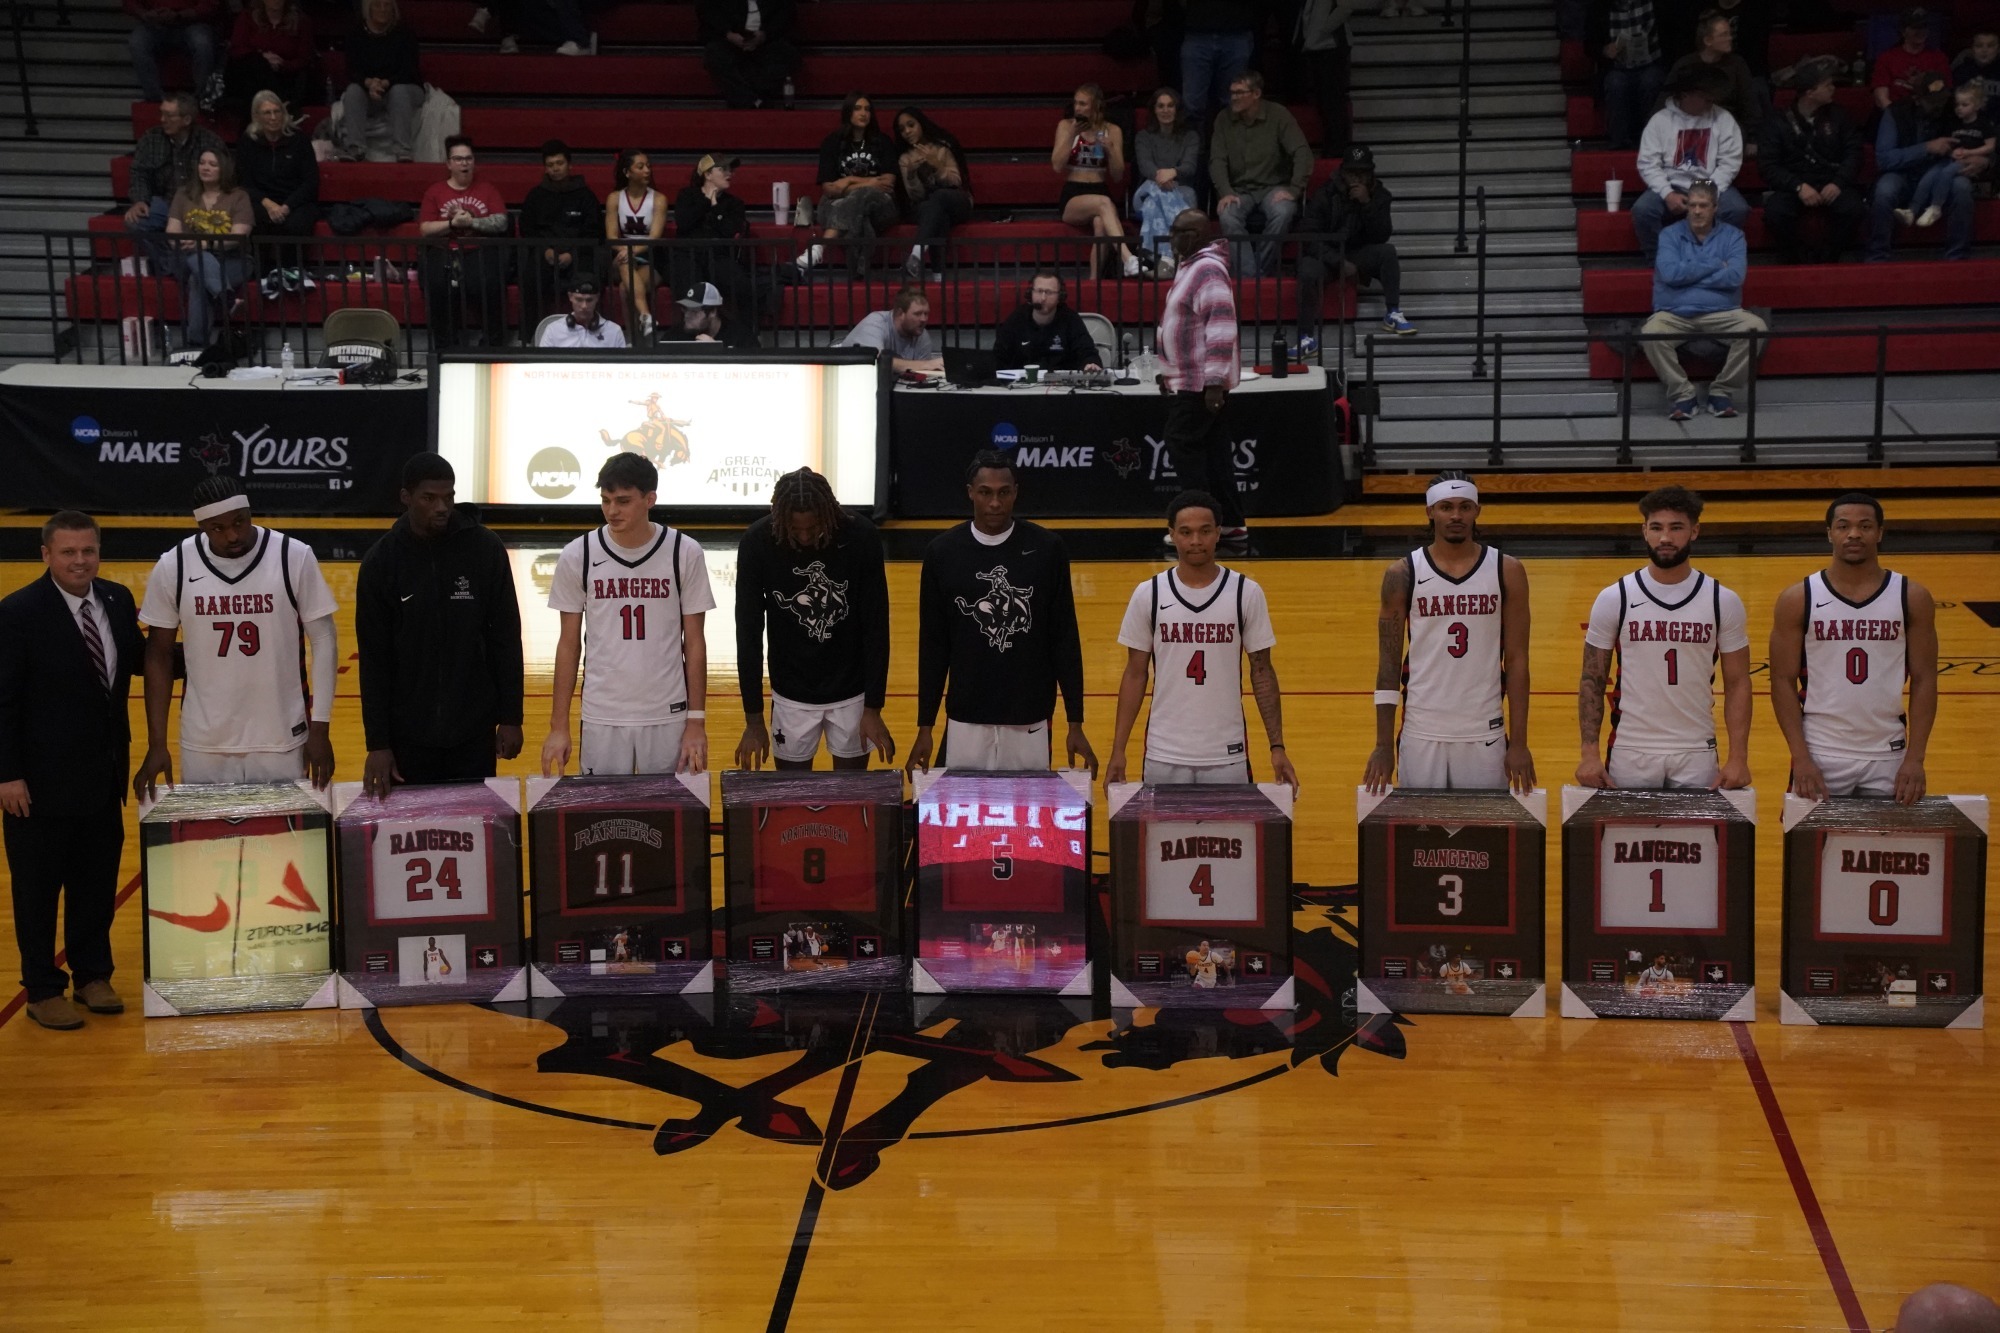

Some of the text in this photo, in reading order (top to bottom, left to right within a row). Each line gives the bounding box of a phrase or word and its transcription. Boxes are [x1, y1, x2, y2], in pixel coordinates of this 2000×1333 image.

[328, 345, 382, 359] NORTHWESTERN
[523, 371, 789, 380] NORTHWESTERN OKLAHOMA STATE UNIVERSITY
[74, 428, 100, 437] NCAA
[994, 434, 1018, 443] NCAA
[1020, 434, 1048, 443] Division
[98, 441, 182, 463] MAKE
[232, 423, 350, 477] YOURS
[725, 456, 766, 466] GREAT
[1016, 446, 1095, 468] MAKE
[530, 471, 581, 487] NCAA
[706, 467, 786, 484] AMERICAN
[594, 577, 670, 599] RANGERS
[195, 593, 274, 616] RANGERS
[1417, 594, 1498, 617] RANGERS
[619, 604, 645, 640] 11
[1159, 622, 1235, 644] RANGERS
[1629, 621, 1713, 643] RANGERS
[1814, 619, 1901, 641] RANGERS
[212, 621, 260, 657] 79
[1447, 622, 1468, 658] 3
[1186, 650, 1206, 685] 4
[1664, 648, 1678, 685] 1
[1846, 647, 1868, 684] 0
[590, 818, 649, 831] NORTHWESTERN
[781, 822, 848, 846] NORTHWESTERN
[390, 829, 474, 855] RANGERS
[574, 825, 663, 851] RANGERS
[1160, 836, 1242, 862] RANGERS
[992, 844, 1014, 880] 5
[1413, 848, 1489, 870] RANGERS
[1614, 840, 1701, 864] RANGERS
[1841, 850, 1930, 875] RANGERS
[595, 853, 634, 895] 11
[803, 848, 825, 884] 8
[405, 857, 462, 902] 24
[1189, 864, 1214, 906] 4
[1649, 868, 1665, 912] 1
[1438, 874, 1463, 916] 3
[1868, 880, 1899, 926] 0
